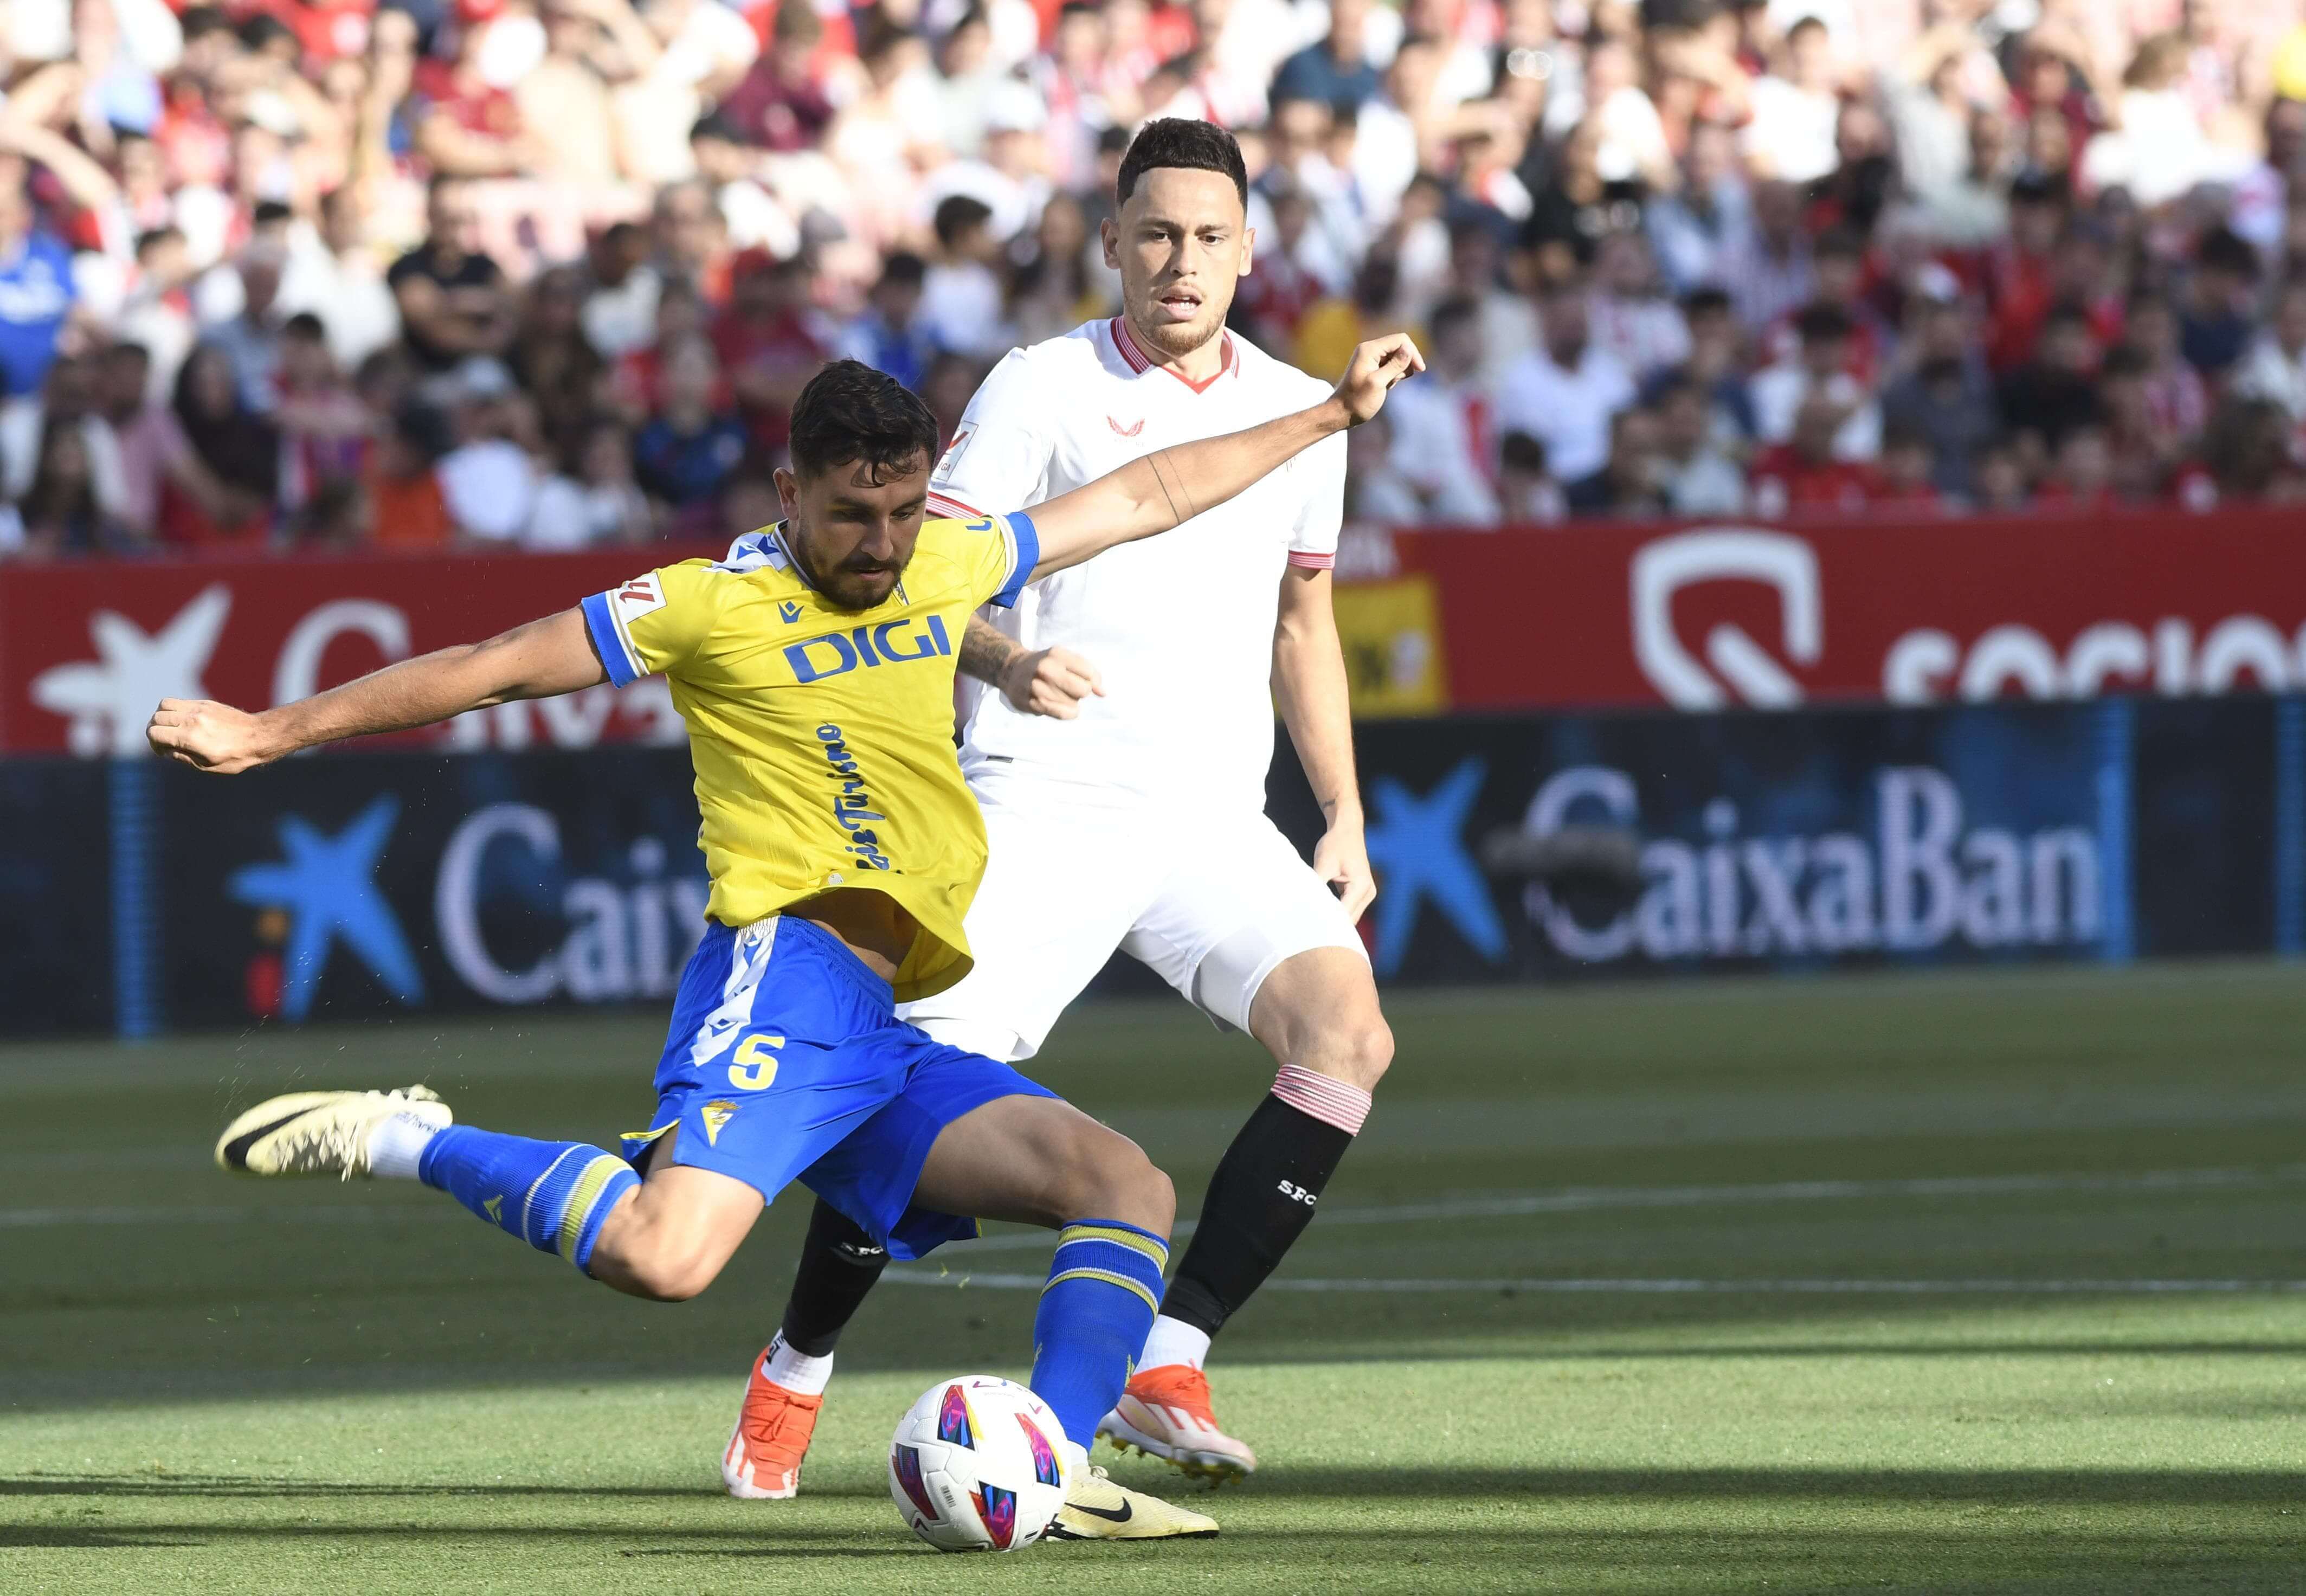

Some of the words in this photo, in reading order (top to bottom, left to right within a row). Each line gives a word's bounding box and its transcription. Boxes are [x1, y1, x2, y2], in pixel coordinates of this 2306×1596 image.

[783, 615, 951, 684] DIGI
[1883, 613, 2306, 704] socio
[728, 1033, 785, 1091] 5
[1277, 1179, 1317, 1205] SFC
